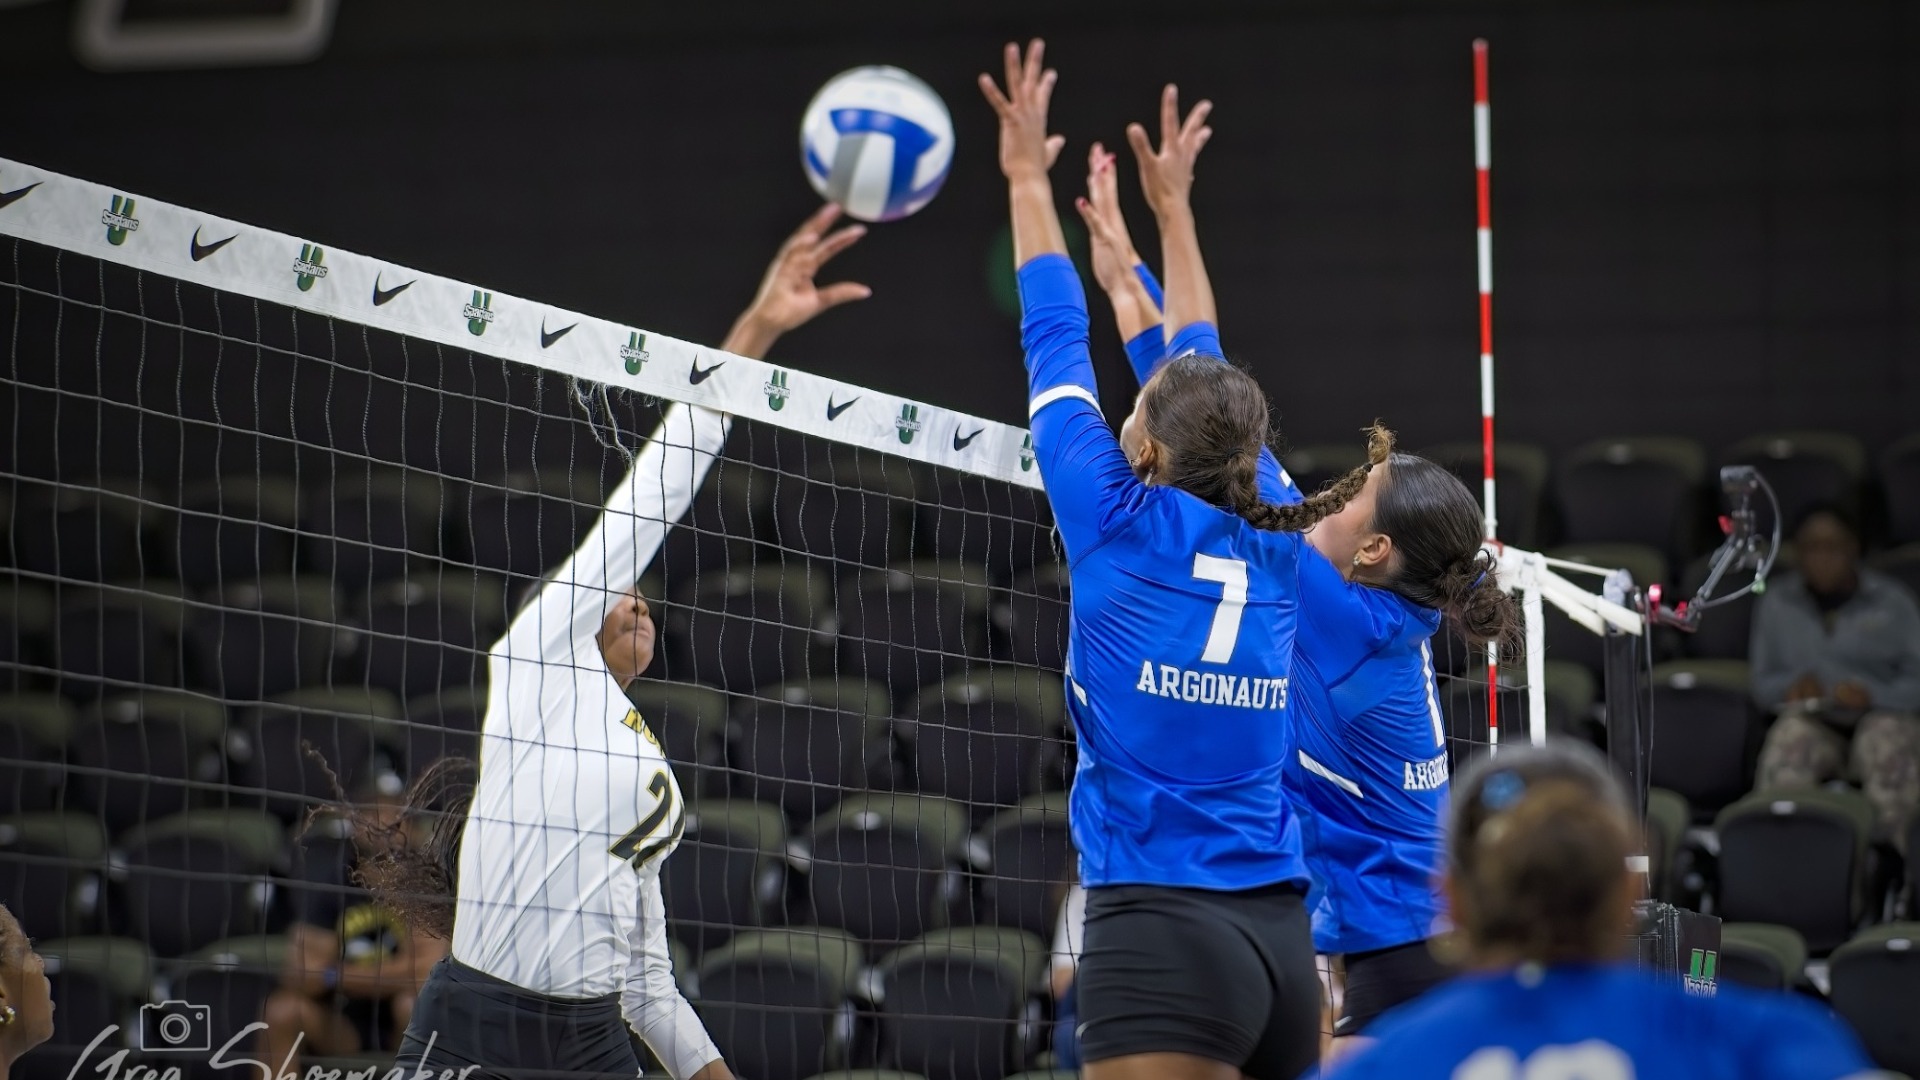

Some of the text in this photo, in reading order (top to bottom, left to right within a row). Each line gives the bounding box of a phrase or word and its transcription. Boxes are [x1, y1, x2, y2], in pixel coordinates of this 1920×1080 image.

[102, 209, 140, 231] Spartans
[293, 257, 329, 279] Spartans
[1192, 552, 1249, 664] 7
[1136, 660, 1289, 711] ARGONAUTS
